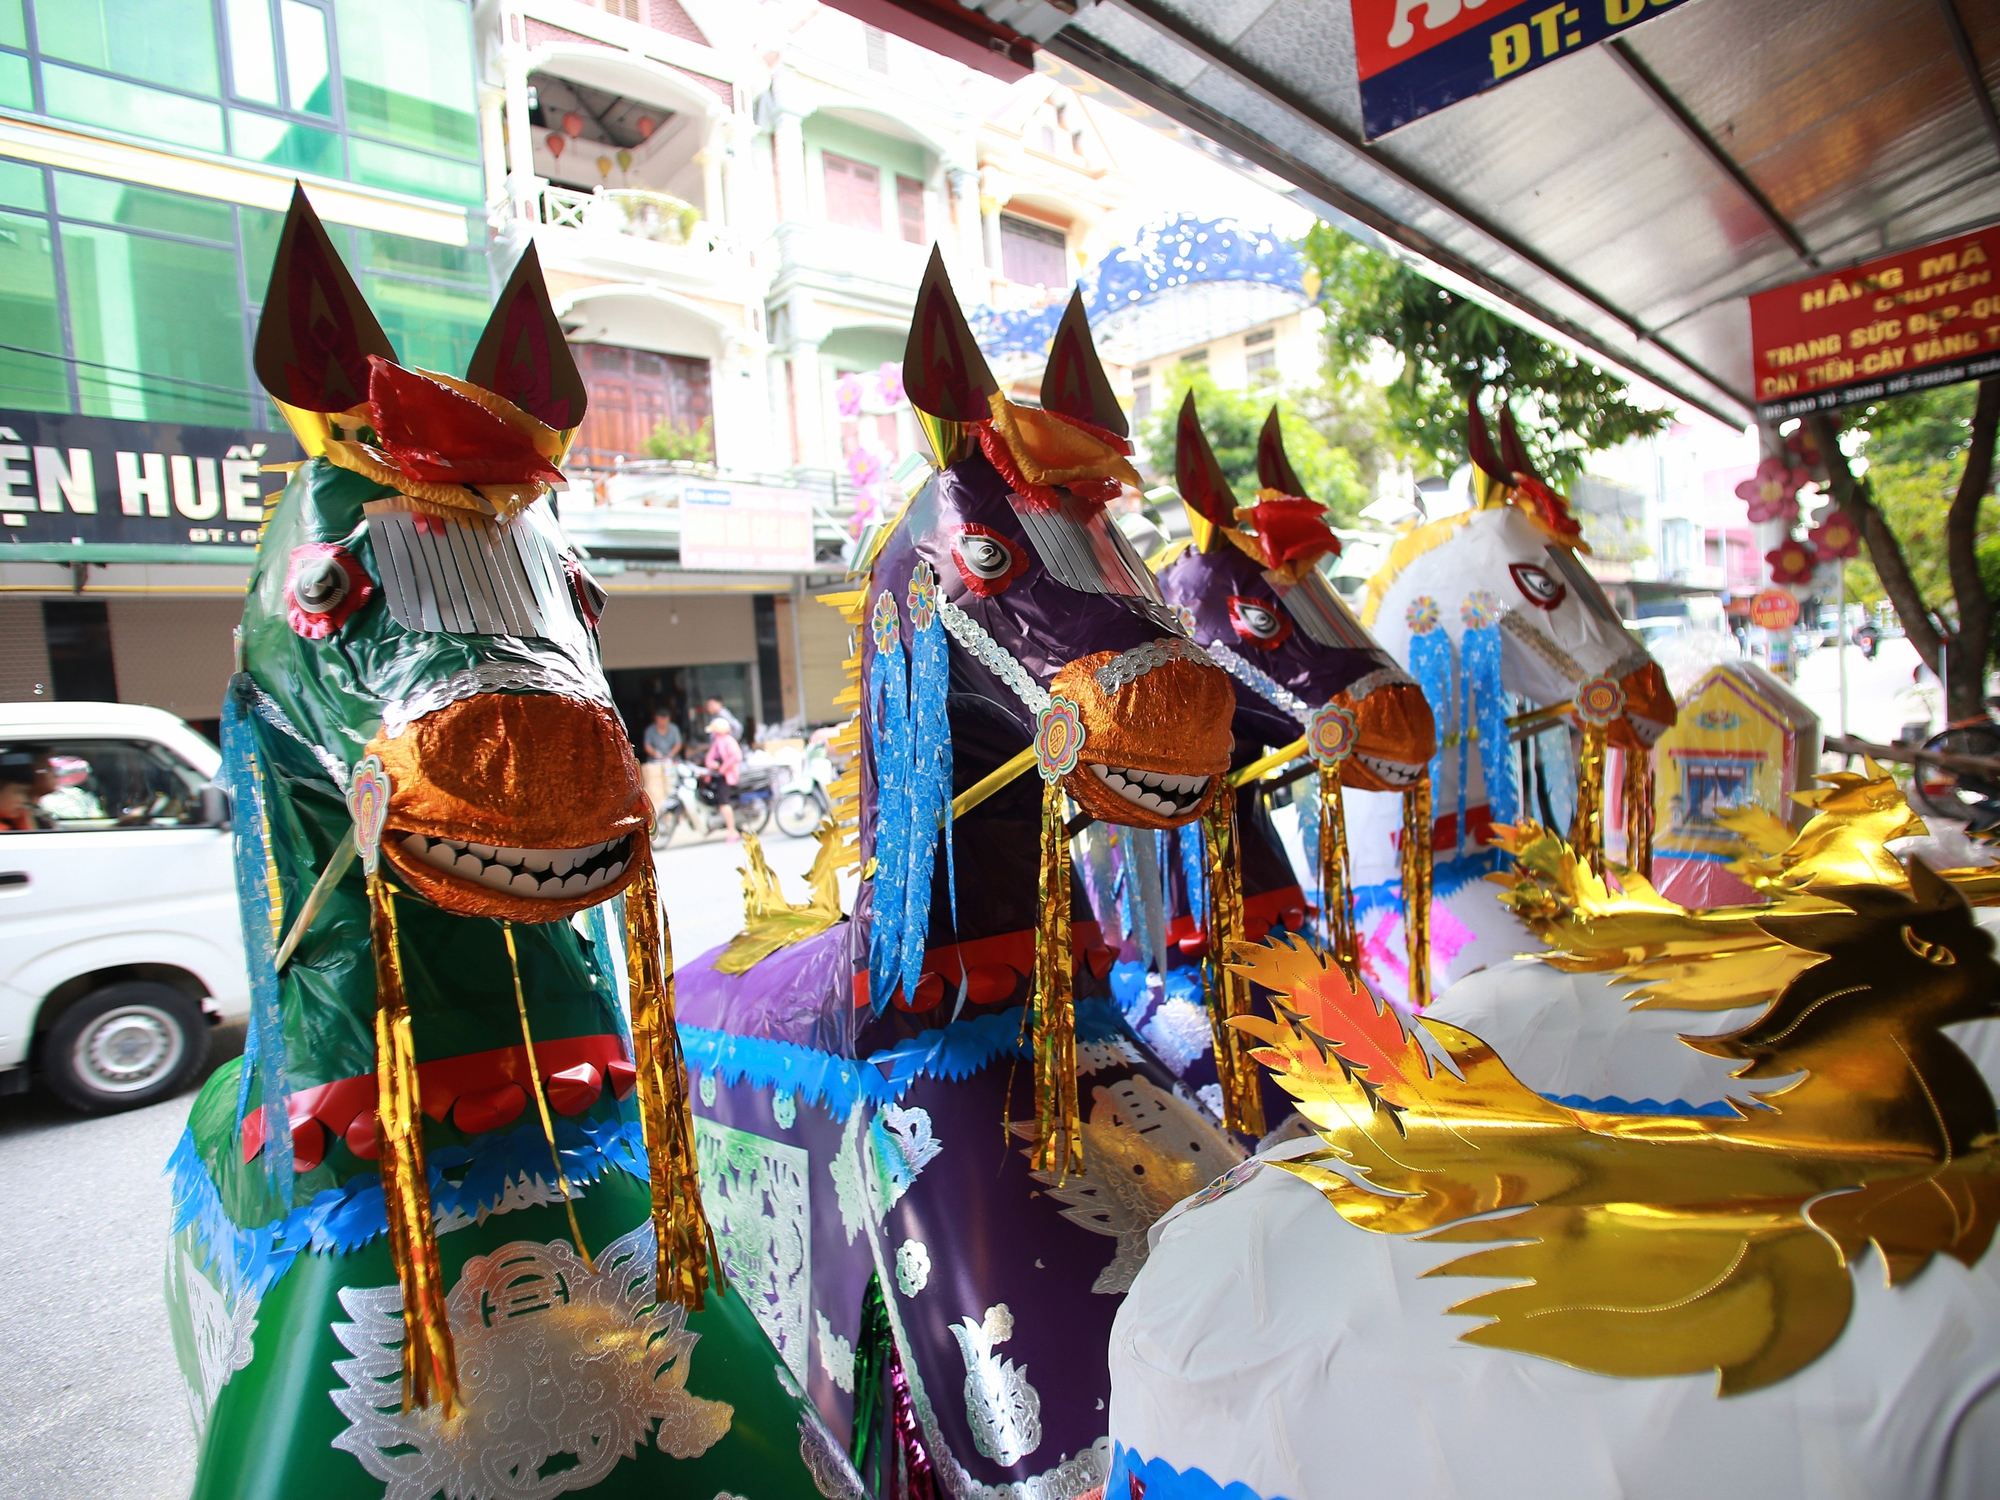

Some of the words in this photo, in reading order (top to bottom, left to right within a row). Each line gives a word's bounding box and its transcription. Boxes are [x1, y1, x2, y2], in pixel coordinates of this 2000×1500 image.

[1489, 1, 1582, 79] ĐT:
[1801, 267, 1904, 313] HÀNG
[1919, 240, 1988, 281] MÃ
[1765, 333, 1842, 368] TRANG
[1848, 317, 1903, 350] SỨC
[1911, 331, 1981, 364] VÀNG
[115, 443, 268, 522] HUẾ
